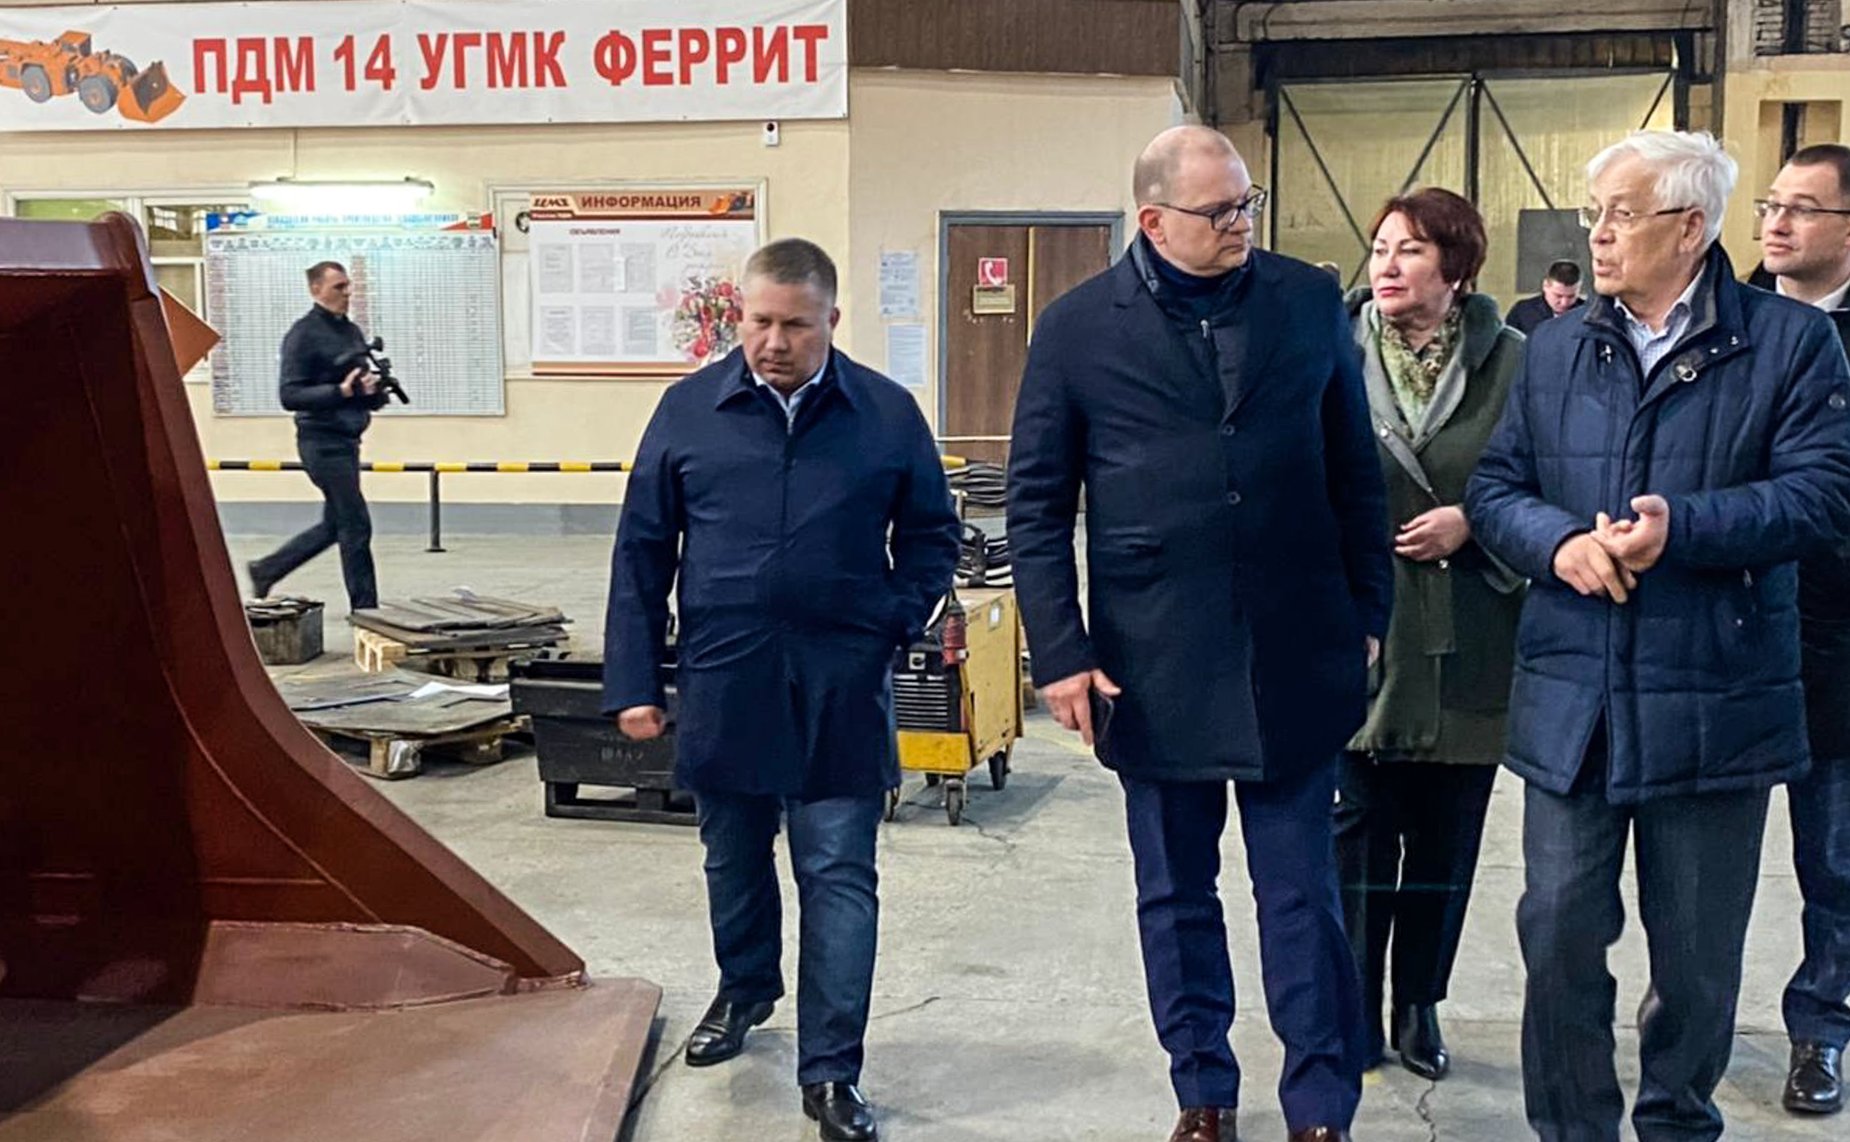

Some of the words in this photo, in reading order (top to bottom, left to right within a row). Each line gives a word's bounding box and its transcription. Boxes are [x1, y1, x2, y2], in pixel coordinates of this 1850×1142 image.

[194, 37, 315, 104] ПДМ
[335, 35, 396, 91] 14
[418, 32, 566, 91] УГМК
[594, 25, 828, 89] ФЕРРИТ
[581, 195, 702, 210] ИНФОРМАЦИЯ
